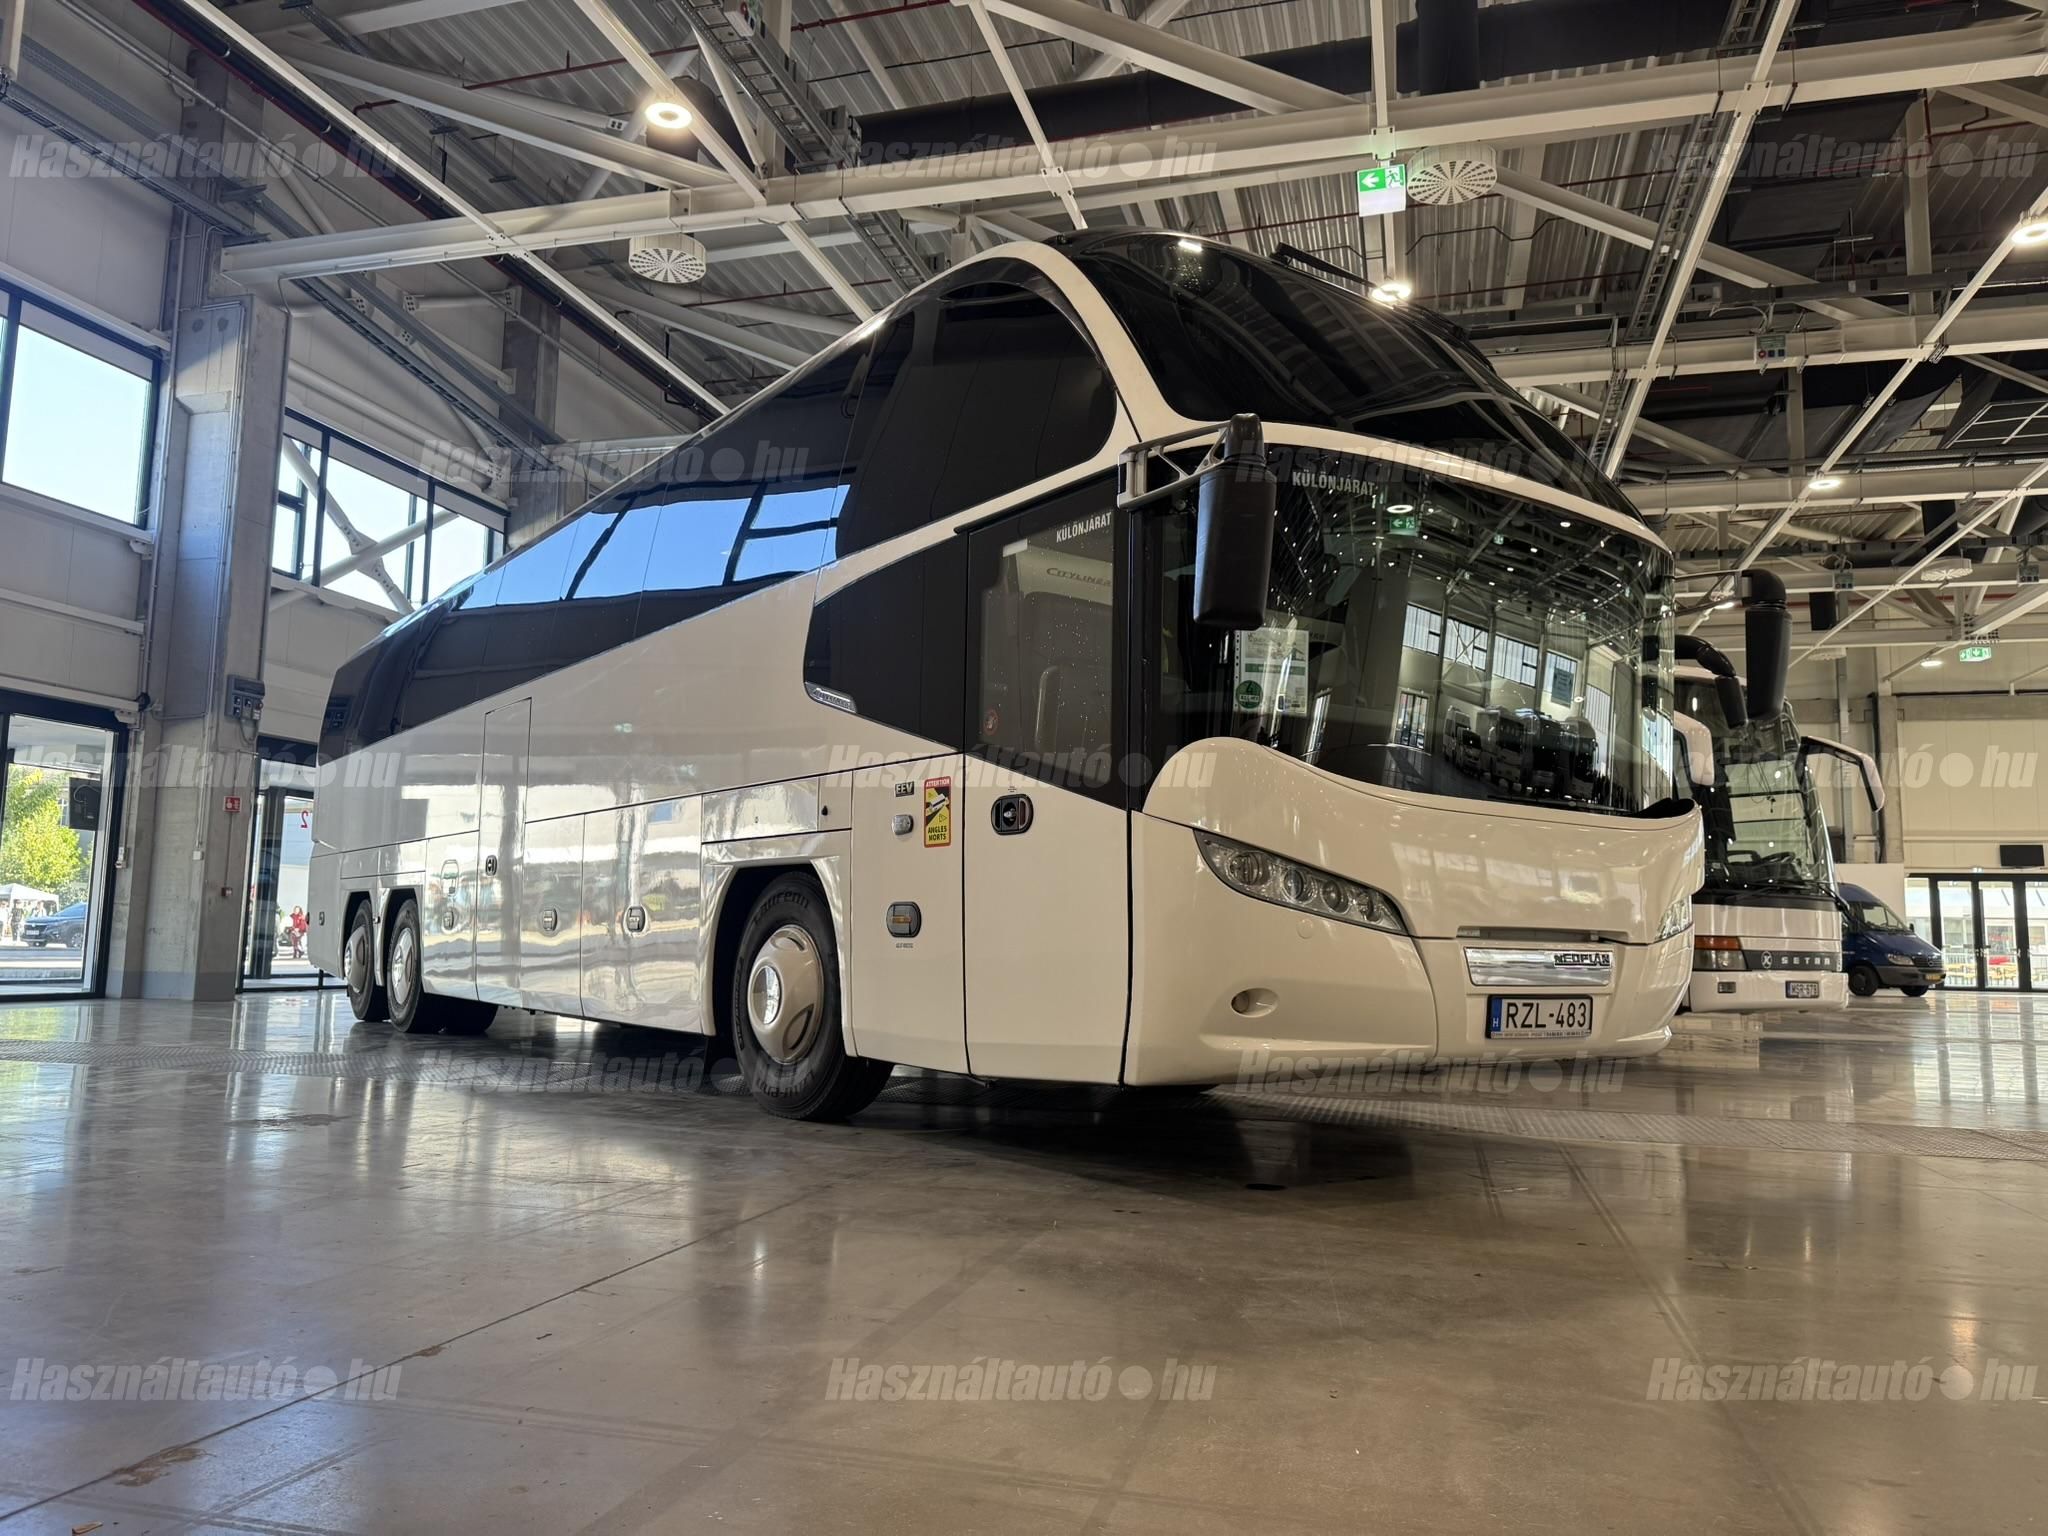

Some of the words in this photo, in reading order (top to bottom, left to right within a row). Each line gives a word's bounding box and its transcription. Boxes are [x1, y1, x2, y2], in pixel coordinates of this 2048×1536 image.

[1292, 468, 1375, 496] KÜLÖNJÁRAT
[1056, 511, 1112, 543] KÜLÖNJÁRAT
[896, 782, 913, 794] EEV
[927, 826, 947, 834] ANGLES
[928, 834, 947, 842] MORTS
[1553, 953, 1610, 966] NEOPLAN
[1505, 1002, 1587, 1029] RZL-483
[1492, 1017, 1499, 1028] H
